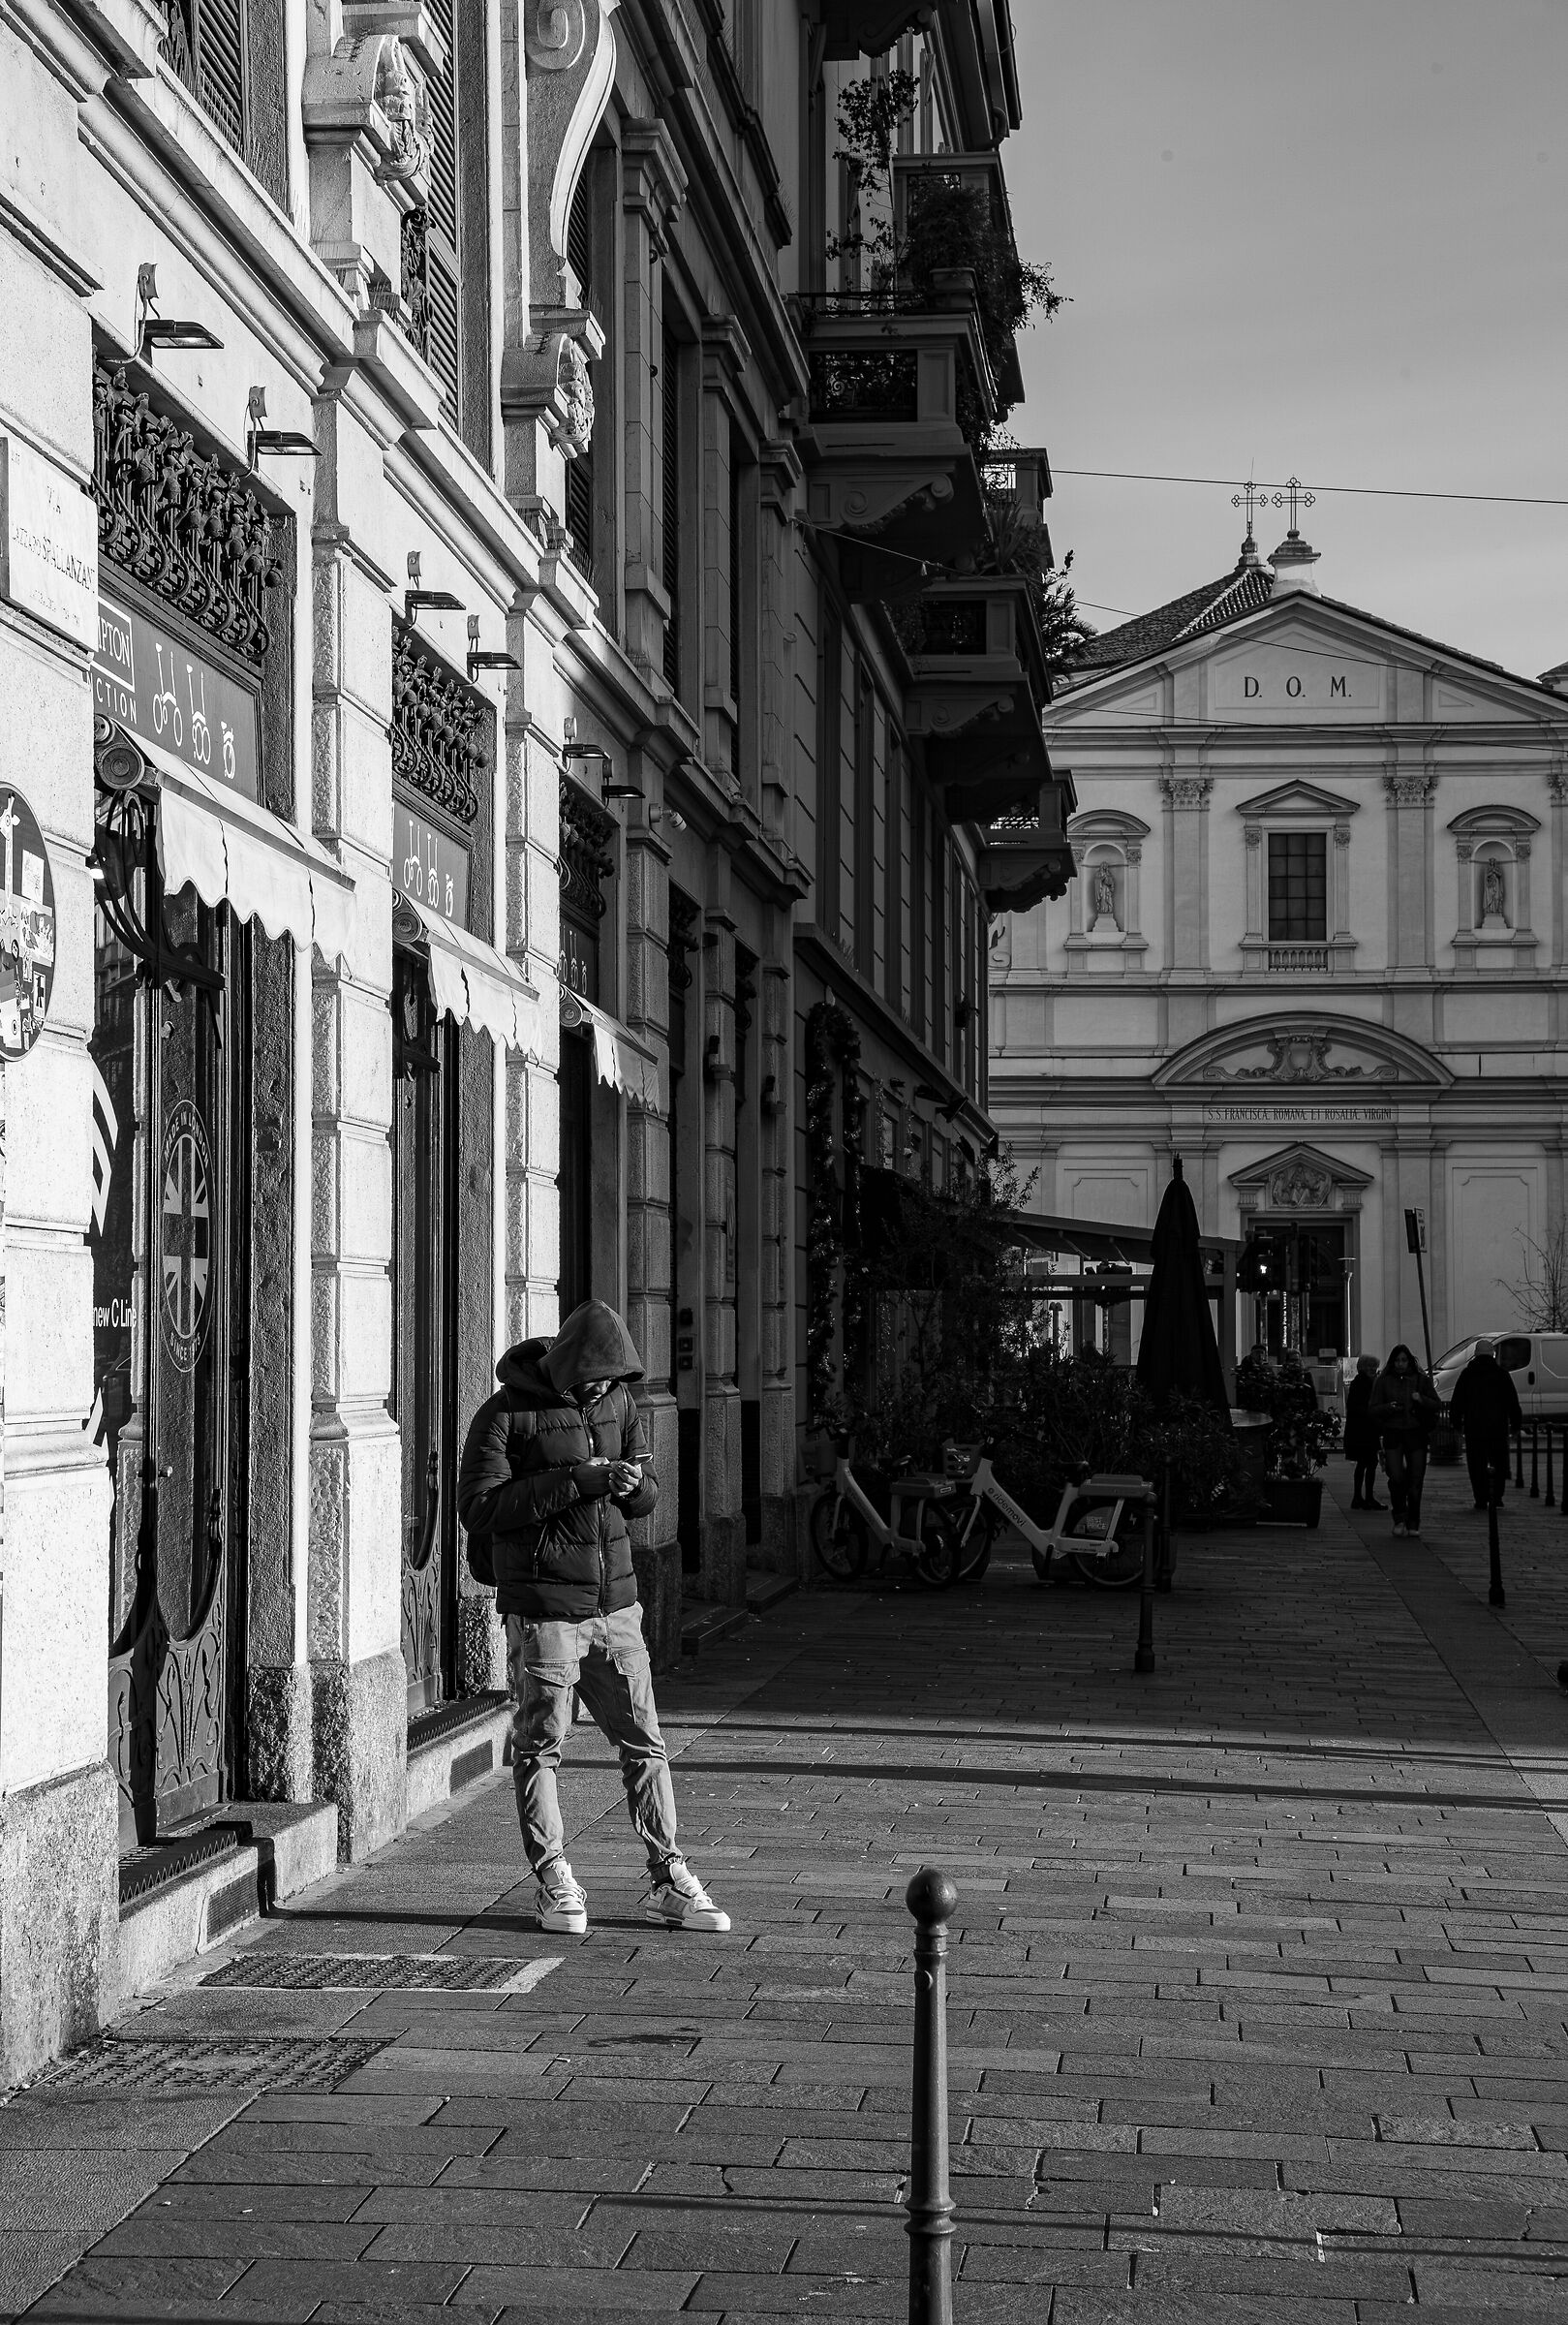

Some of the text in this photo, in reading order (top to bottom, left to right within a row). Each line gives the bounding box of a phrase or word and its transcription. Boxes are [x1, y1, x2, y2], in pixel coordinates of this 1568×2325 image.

[1244, 676, 1352, 698] D. O. M.
[164, 1111, 209, 1169] MADE IN LONDON
[111, 1298, 119, 1328] C
[120, 1299, 137, 1328] Line
[169, 1332, 188, 1361] SINCE
[993, 1494, 1027, 1527] ridemovi
